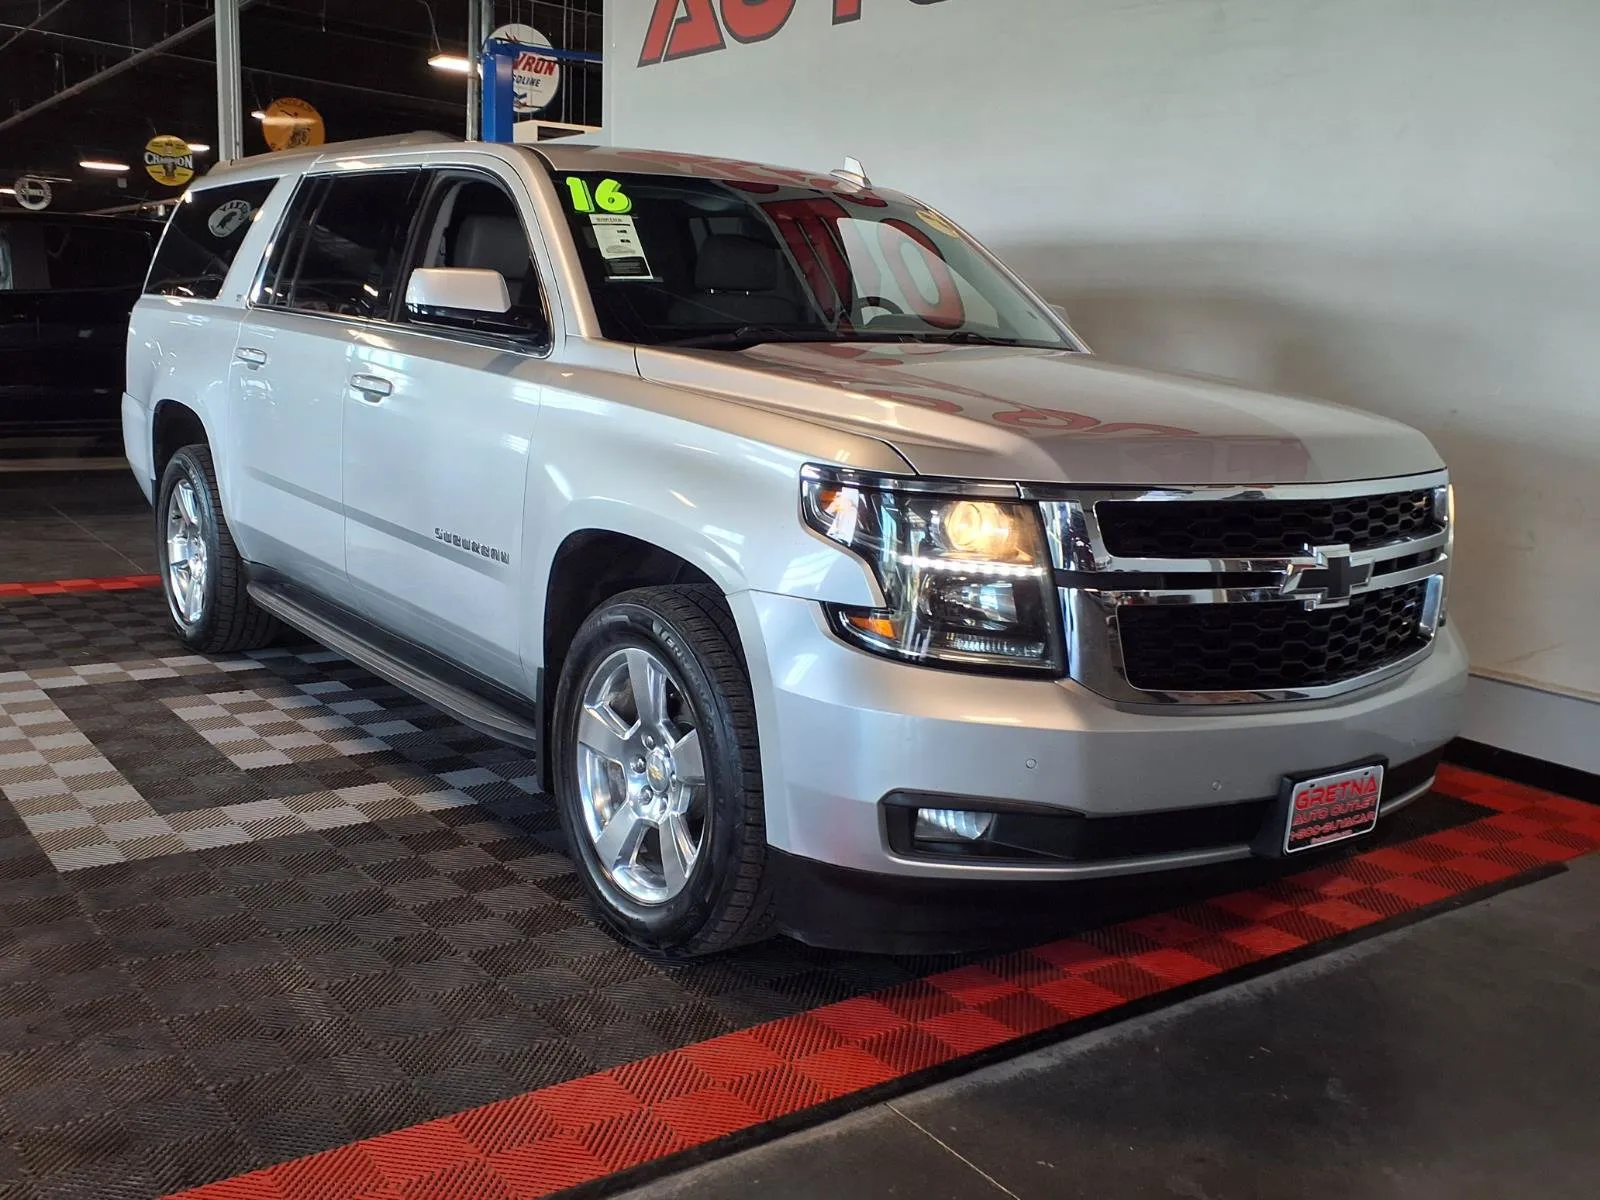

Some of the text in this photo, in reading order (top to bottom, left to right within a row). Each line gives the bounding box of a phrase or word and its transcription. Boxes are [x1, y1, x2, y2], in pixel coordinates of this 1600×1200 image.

[566, 176, 633, 213] 16
[434, 527, 510, 565] SUBURBAN
[1295, 775, 1377, 811] GRETNA
[1292, 807, 1329, 826] AUTO
